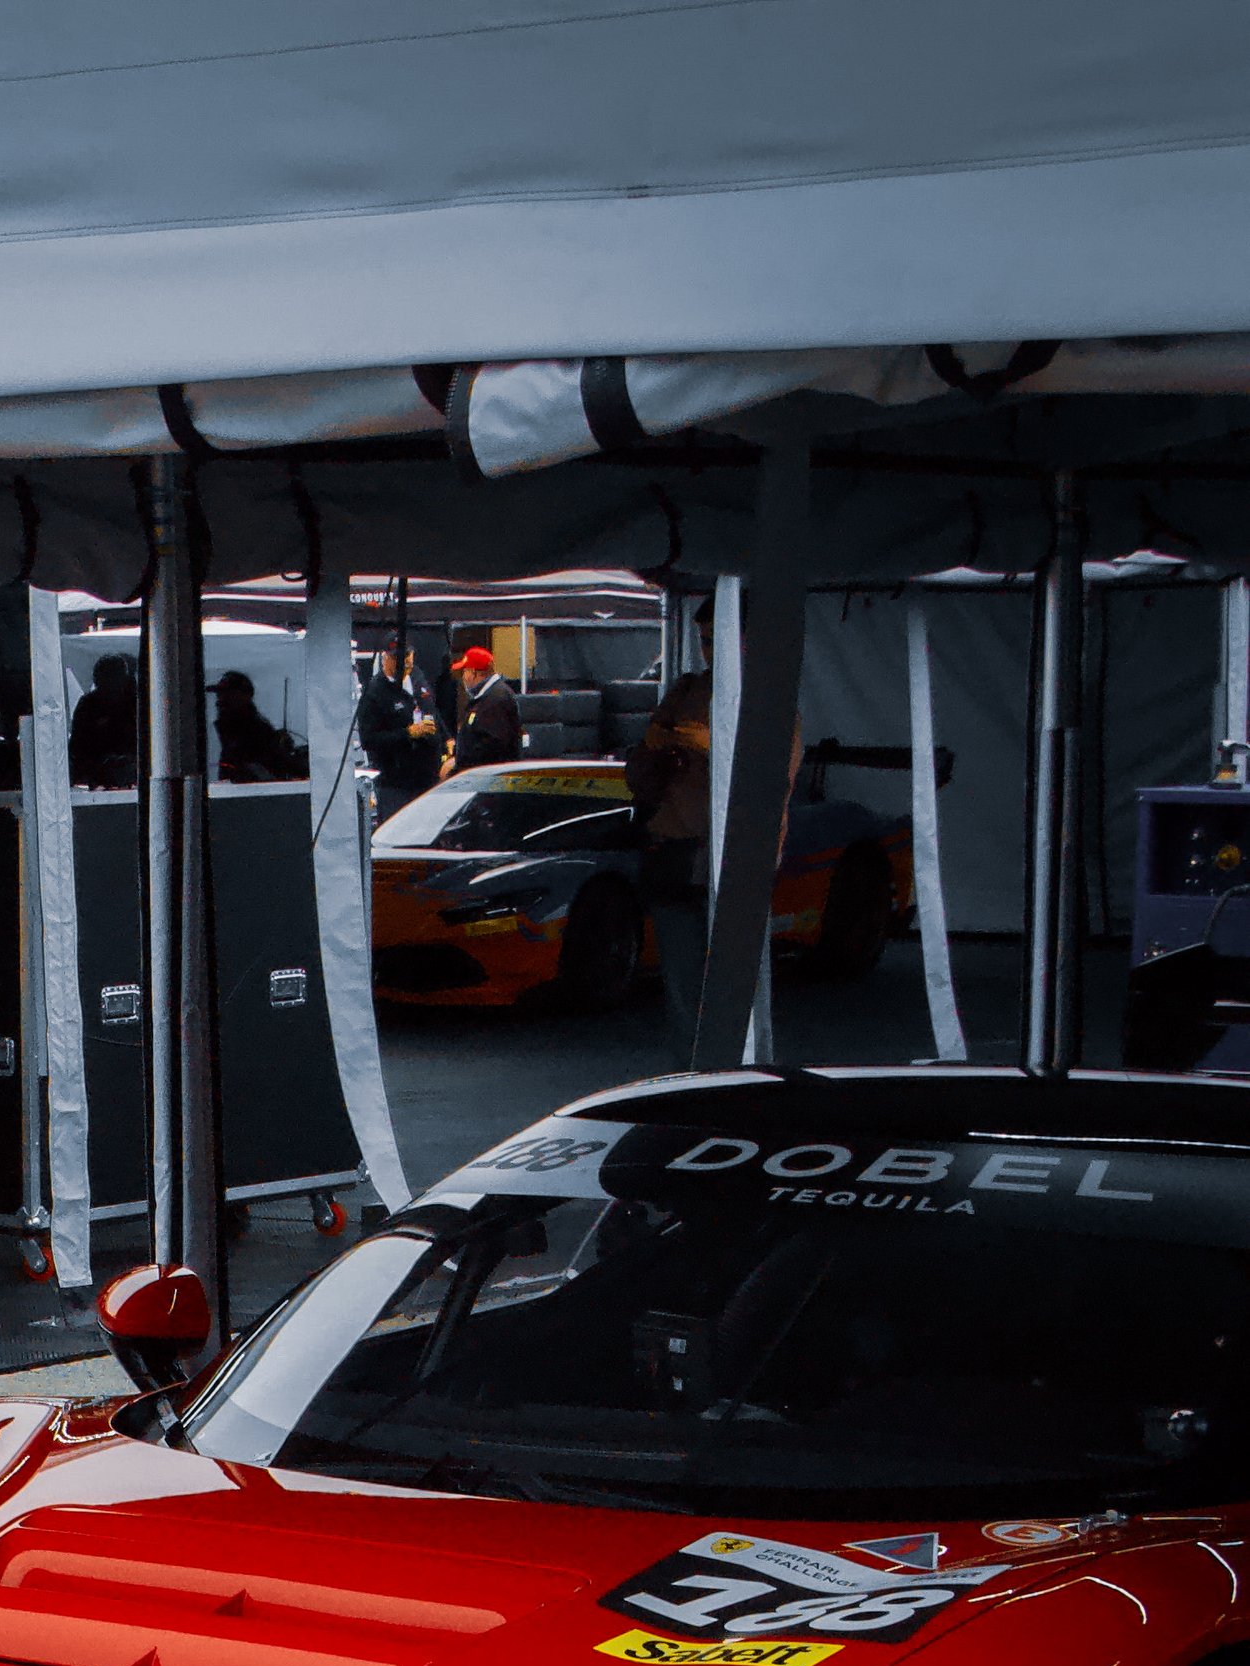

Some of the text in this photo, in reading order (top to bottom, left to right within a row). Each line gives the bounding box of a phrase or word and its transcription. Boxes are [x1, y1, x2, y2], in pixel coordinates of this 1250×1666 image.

[664, 1136, 1154, 1202] DOBEL
[766, 1186, 976, 1216] TEQUILA
[755, 1553, 858, 1588] CHALLENGE
[762, 1548, 842, 1576] FERRARI
[623, 1574, 955, 1633] 188
[624, 1639, 813, 1666] Sabelt
